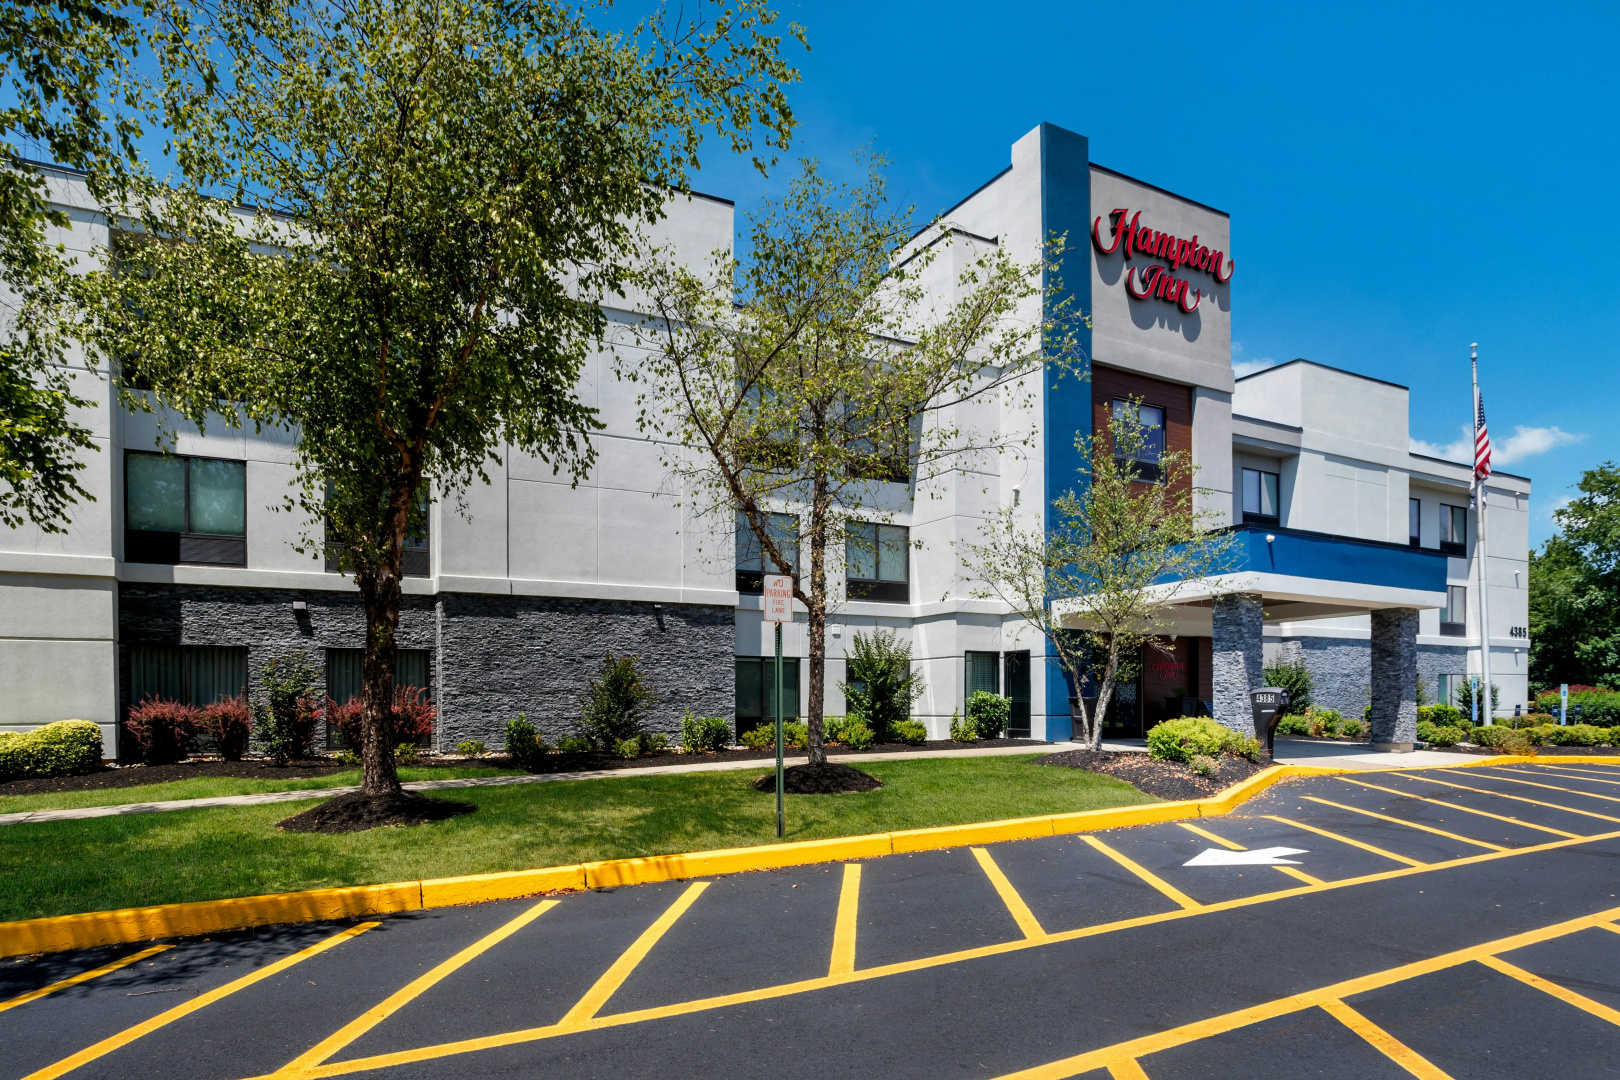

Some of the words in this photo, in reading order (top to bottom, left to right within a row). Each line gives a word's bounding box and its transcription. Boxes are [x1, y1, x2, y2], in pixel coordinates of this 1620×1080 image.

[1092, 208, 1235, 283] Hampton
[1126, 264, 1201, 313] Inn
[773, 579, 784, 588] NO
[766, 588, 791, 599] PARKING
[1510, 626, 1527, 638] 4385
[1151, 660, 1187, 672] Hampton
[1256, 694, 1274, 703] 4385
